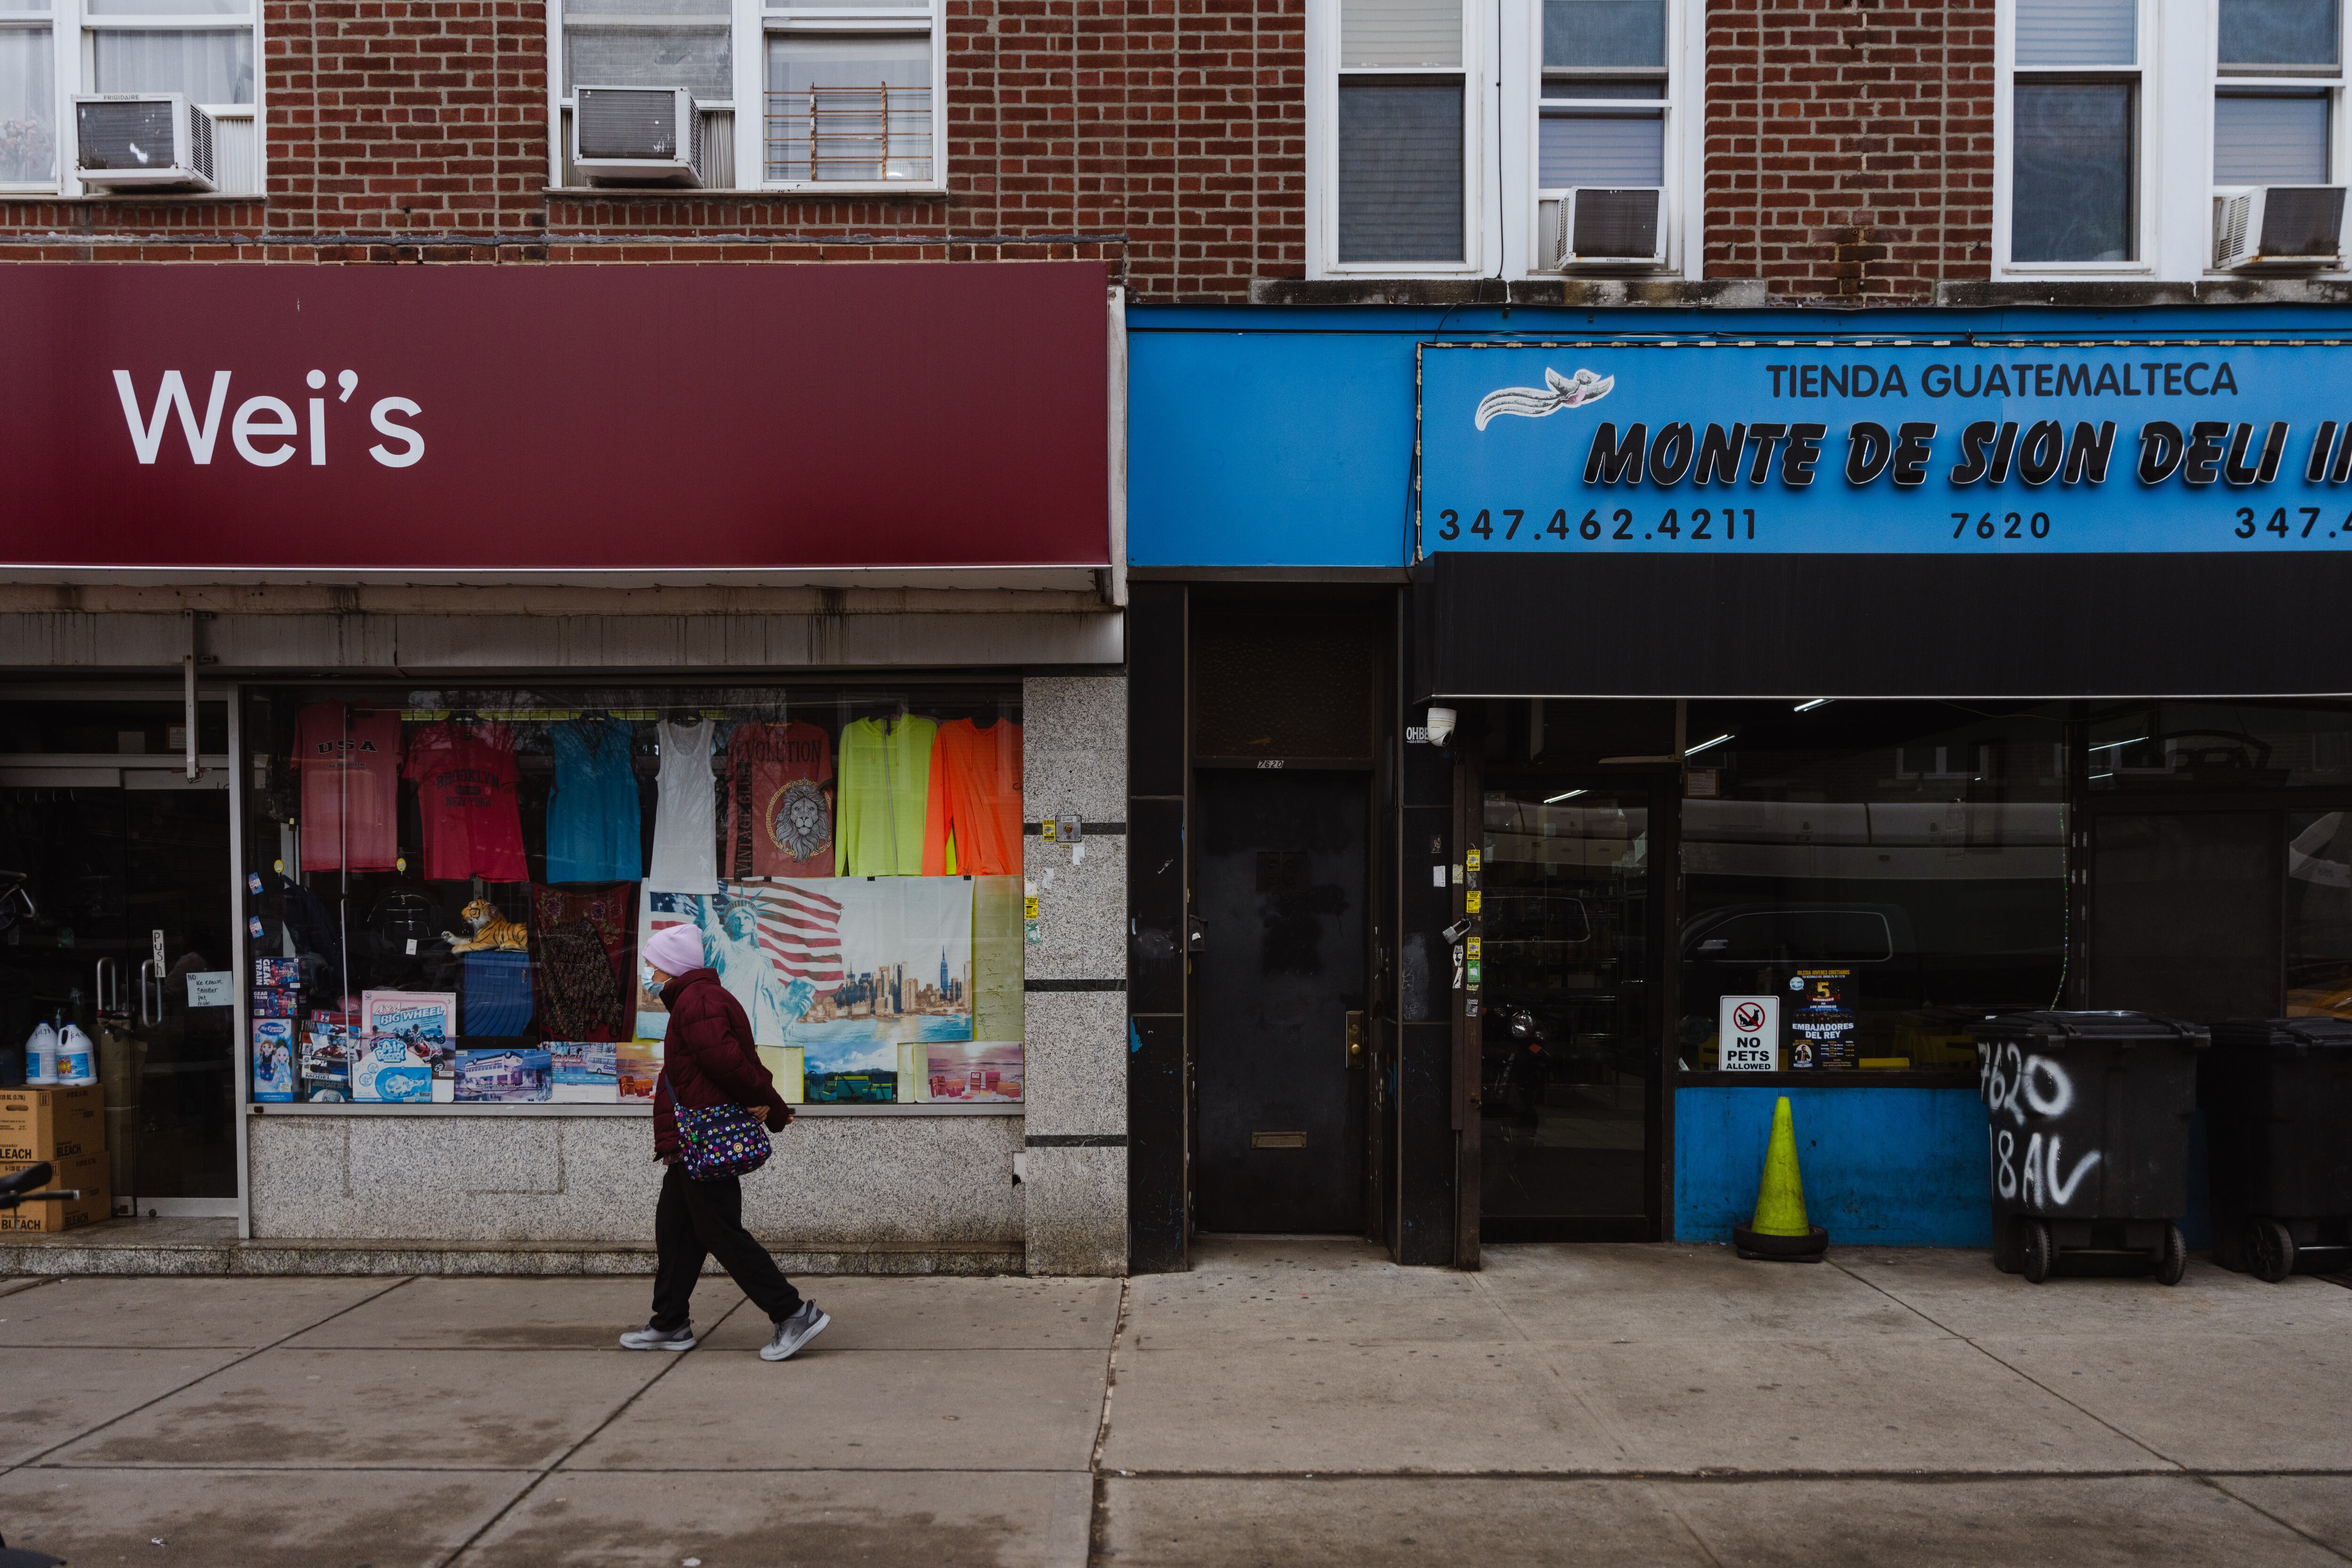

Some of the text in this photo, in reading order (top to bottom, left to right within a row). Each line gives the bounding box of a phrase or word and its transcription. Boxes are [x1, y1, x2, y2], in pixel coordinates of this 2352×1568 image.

[1766, 362, 2238, 398] TIENDA GUATEMALTECA
[112, 369, 425, 468] Wei's
[1583, 421, 1828, 485] MONTE
[1845, 421, 1938, 485] DE
[1949, 420, 2117, 485] SION
[2137, 420, 2290, 485] DELI
[1439, 509, 1756, 541] 347.462.4211
[1951, 512, 2050, 539] 7620
[316, 739, 377, 754] USA
[446, 796, 491, 807] NEW YORK
[1817, 982, 1830, 998] 5
[380, 1006, 445, 1026] BIG WHEEL
[1792, 1023, 1854, 1031] EMBAJADORES
[1737, 1037, 1761, 1048] NO
[1805, 1031, 1841, 1039] DEL REY
[382, 1040, 405, 1053] Air
[1727, 1050, 1769, 1061] PETS
[1977, 1042, 2073, 1126] 7620
[57, 1144, 81, 1157] BLEACH
[2, 1220, 40, 1230] BLEACH
[65, 1212, 88, 1227] BLEACH
